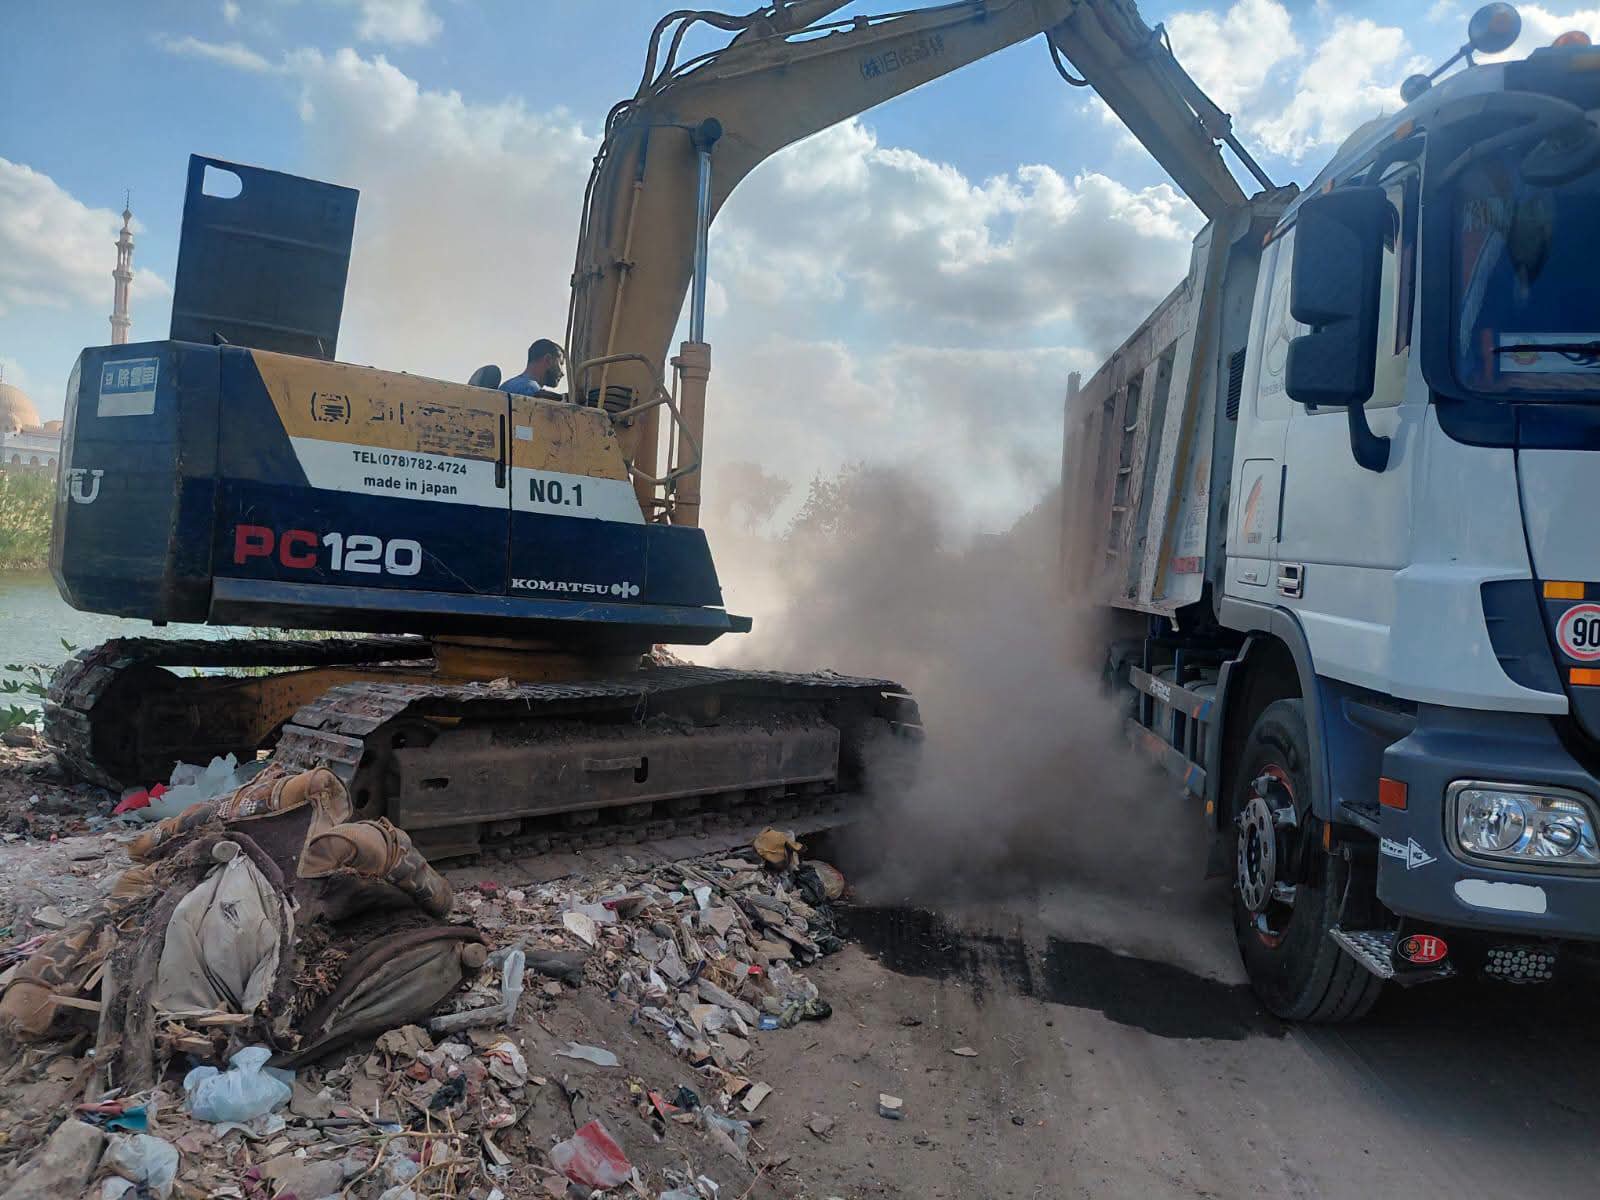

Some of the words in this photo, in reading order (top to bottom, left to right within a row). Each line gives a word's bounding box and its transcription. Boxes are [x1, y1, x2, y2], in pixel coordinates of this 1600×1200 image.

[353, 450, 467, 475] TEL(078)782-4724
[364, 476, 400, 489] made
[405, 479, 417, 491] in
[421, 481, 457, 496] japan
[529, 478, 583, 507] NO.1
[234, 524, 422, 576] PC120
[511, 578, 608, 595] KOMATSU
[1572, 617, 1600, 647] 90
